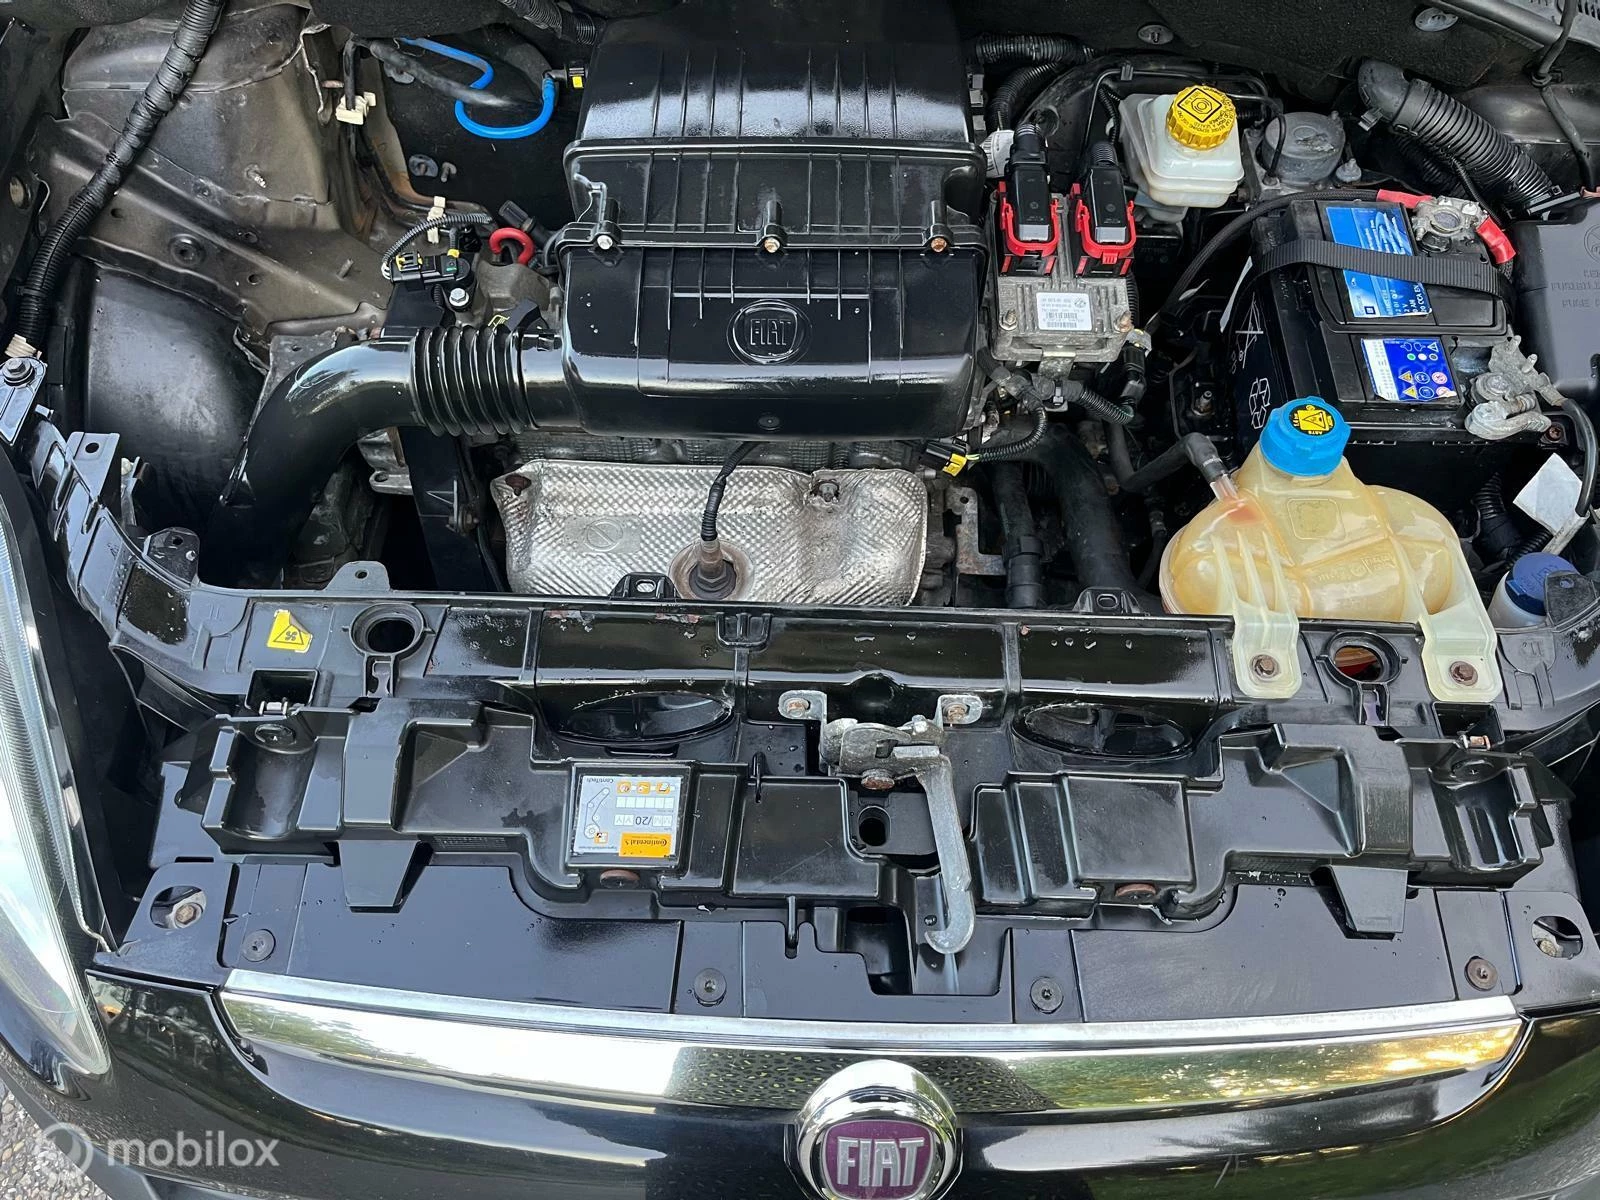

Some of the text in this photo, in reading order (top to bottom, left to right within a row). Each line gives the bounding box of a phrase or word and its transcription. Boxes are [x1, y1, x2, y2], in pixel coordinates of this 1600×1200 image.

[751, 319, 791, 345] FIAT
[635, 816, 653, 825] /20
[837, 1136, 924, 1187] FIAT
